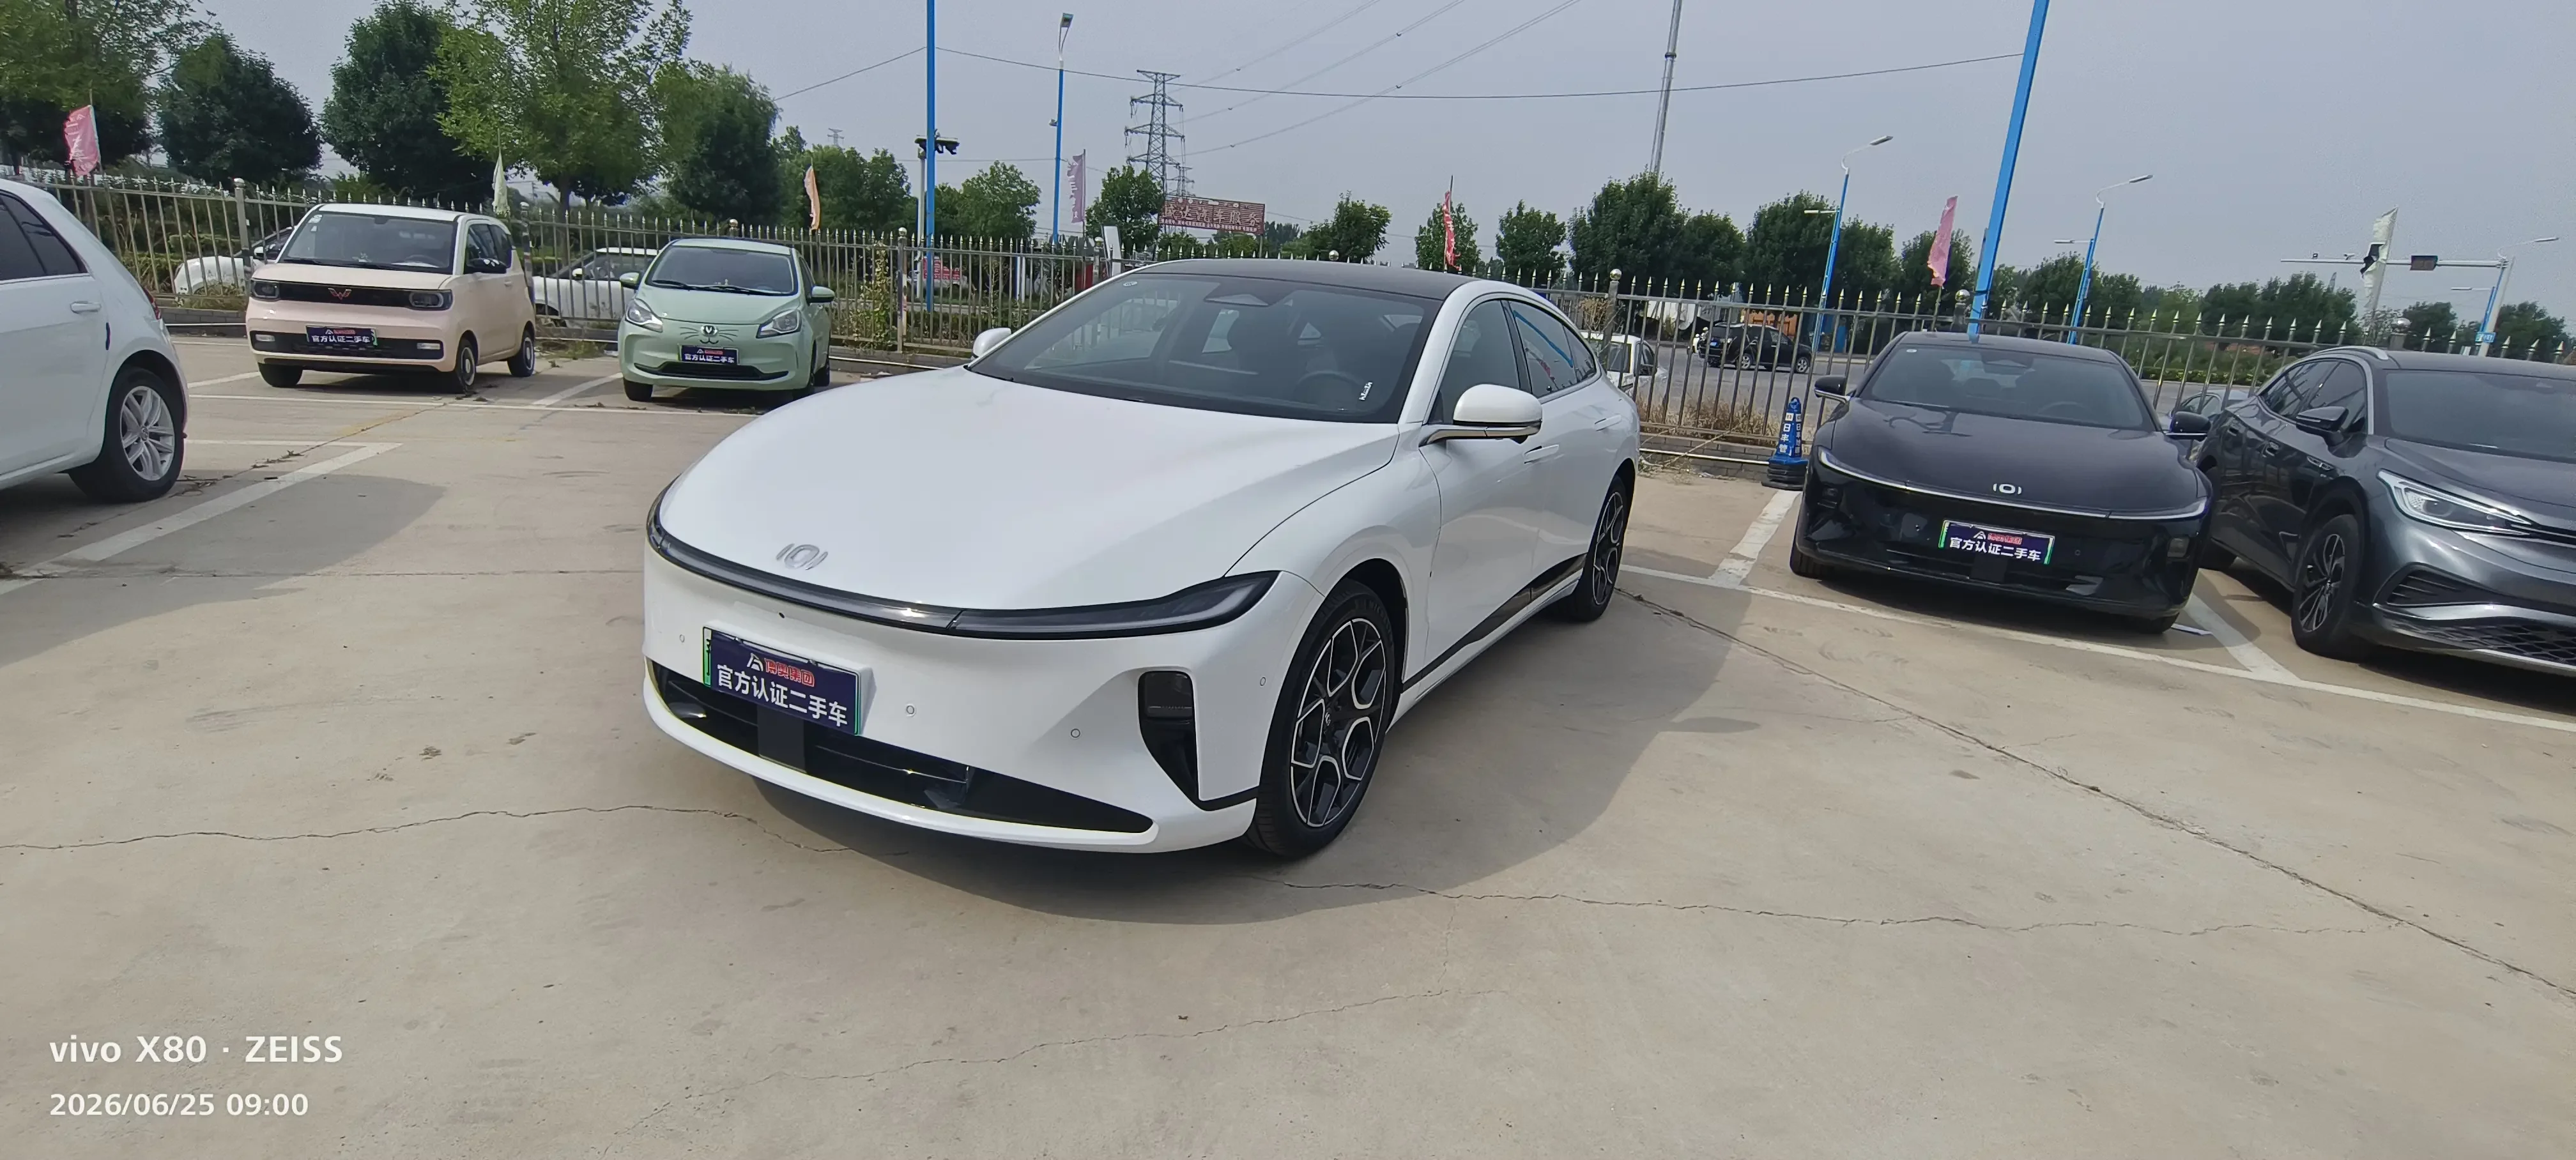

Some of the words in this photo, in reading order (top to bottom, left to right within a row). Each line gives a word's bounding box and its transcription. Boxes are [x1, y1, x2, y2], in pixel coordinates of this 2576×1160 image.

[1949, 537, 2041, 561] 官方认证二手车
[717, 664, 847, 727] 官方认证二手车
